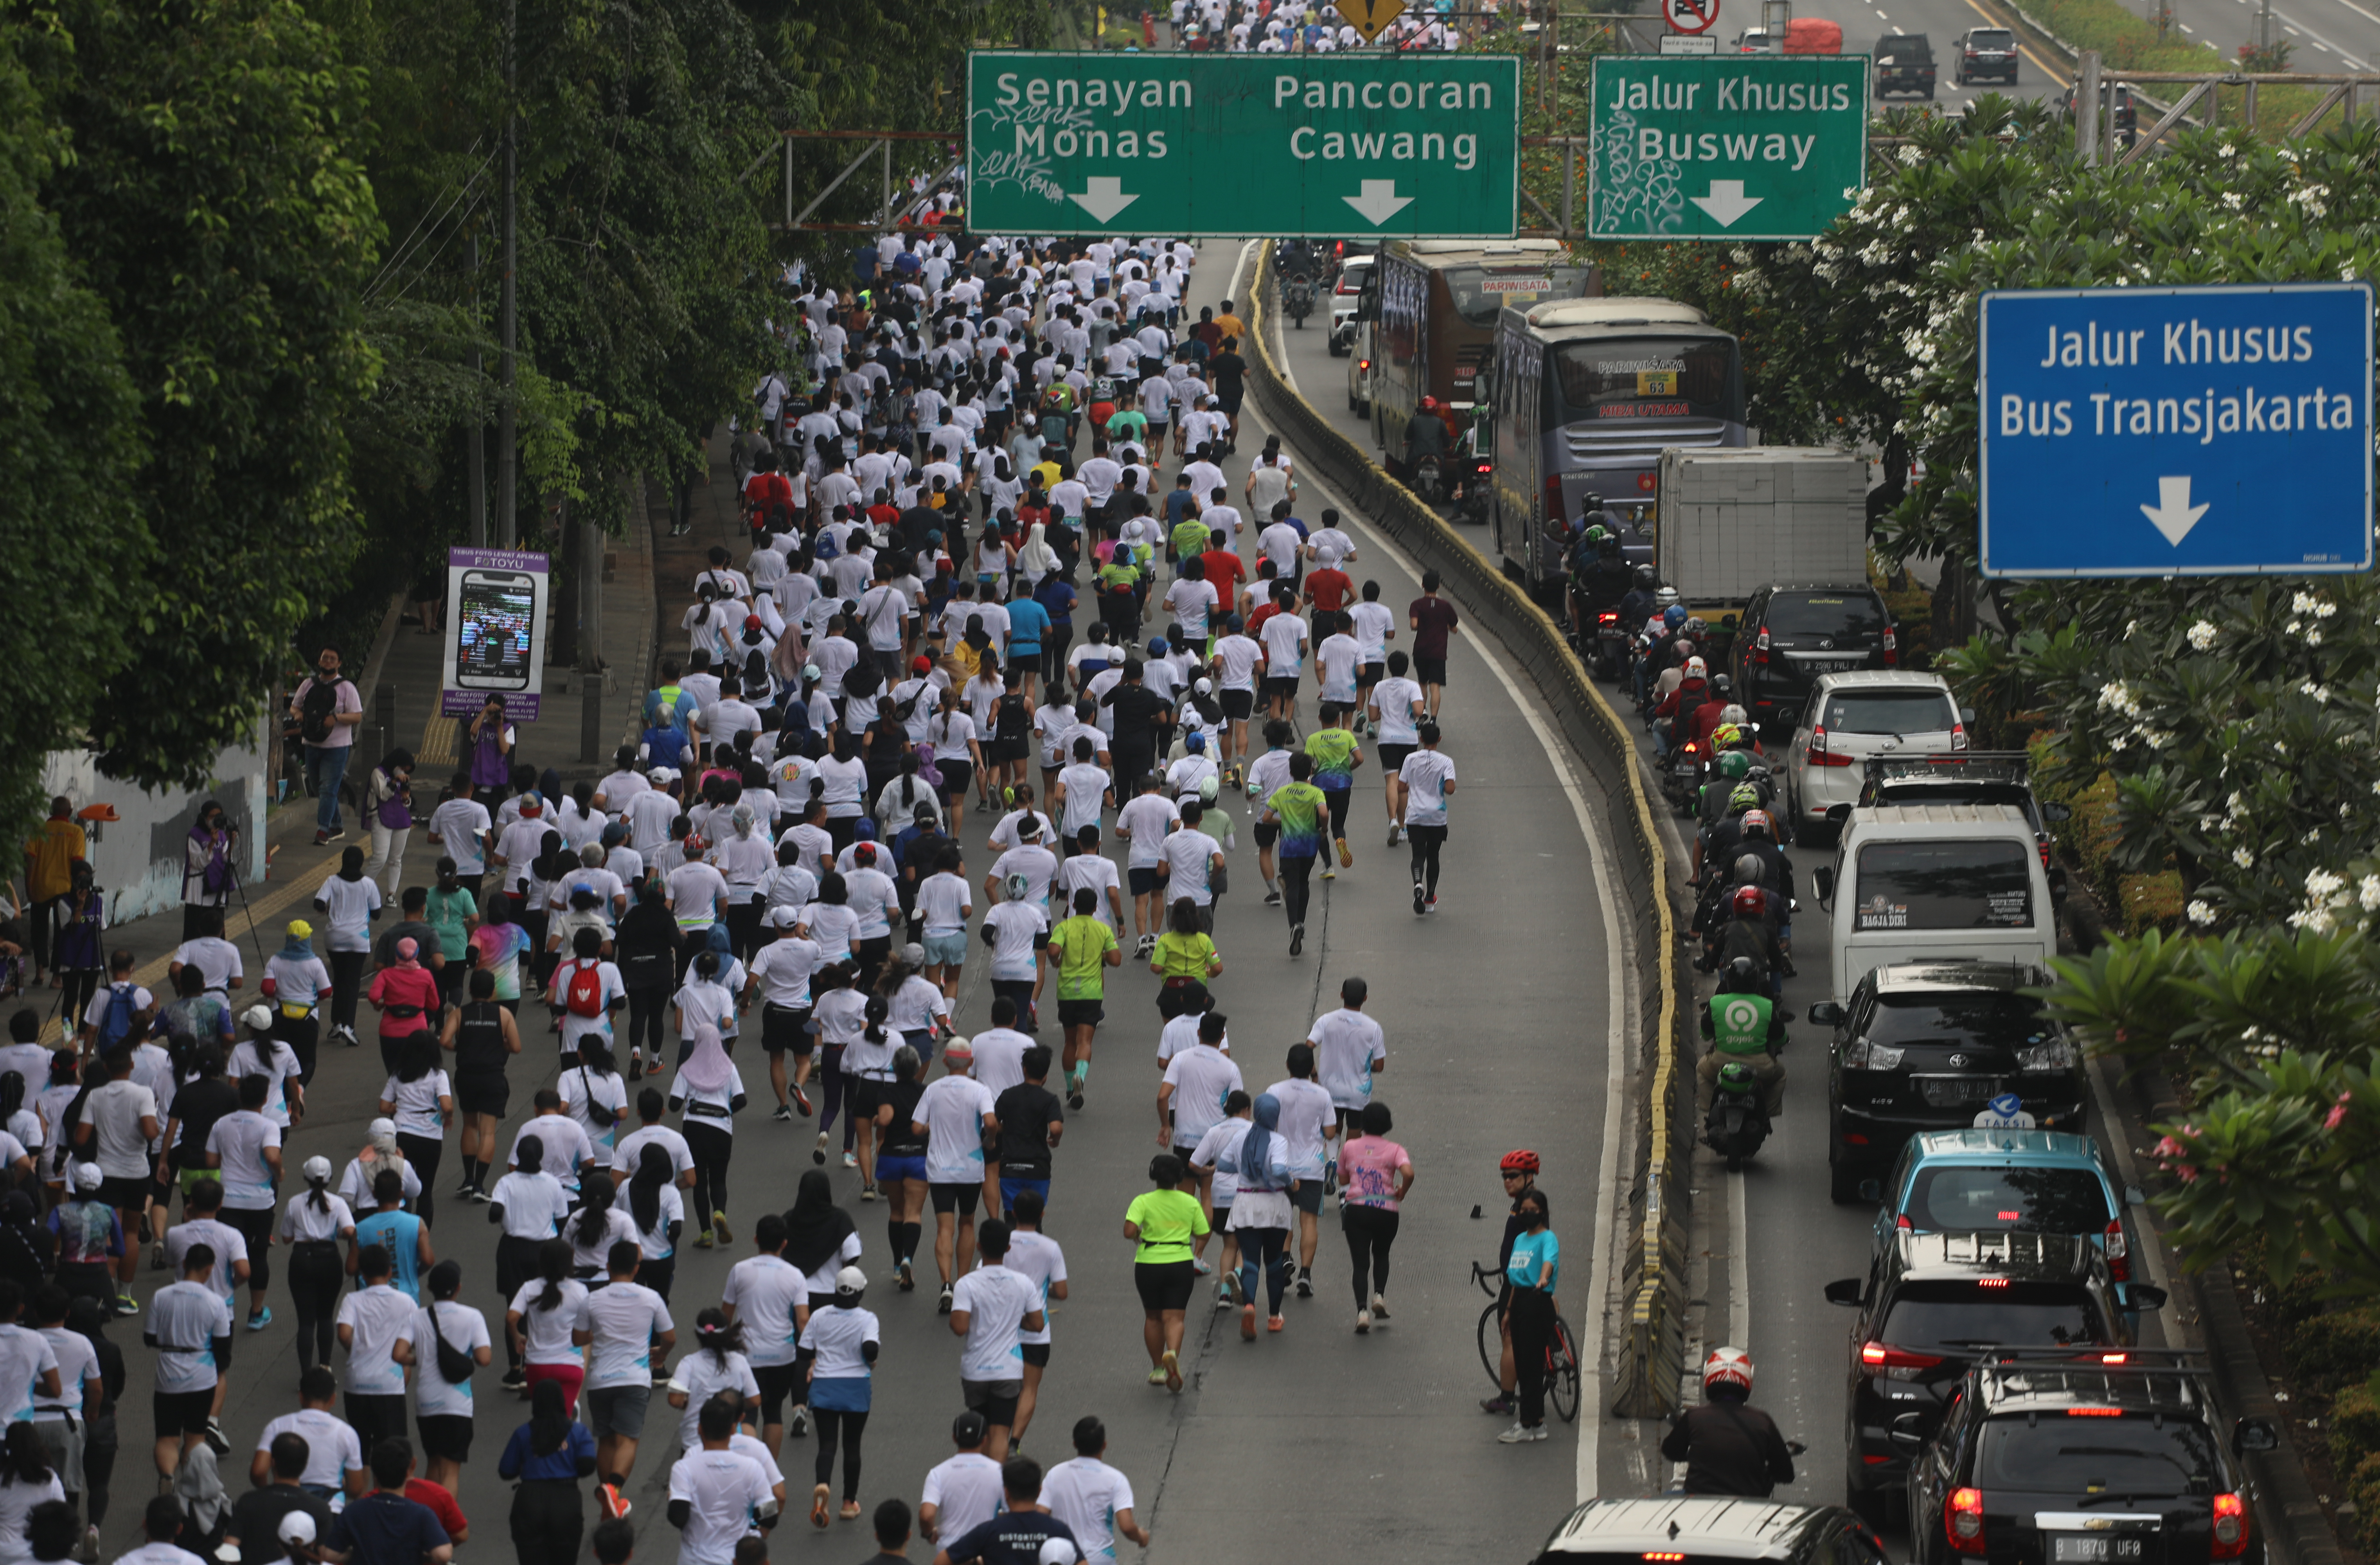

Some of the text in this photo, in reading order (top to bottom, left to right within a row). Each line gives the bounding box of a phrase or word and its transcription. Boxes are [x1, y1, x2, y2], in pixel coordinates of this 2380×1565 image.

[998, 72, 1192, 116] Senayan
[1275, 75, 1491, 109] Pancoran
[1609, 75, 1850, 111] Jalur Khusus
[1016, 124, 1167, 158] Monas
[1291, 126, 1477, 171] Cawang
[1638, 128, 1816, 171] Busway
[1483, 281, 1549, 292] PARIWISATA
[2040, 319, 2312, 368] Jalur Khusus
[1454, 367, 1476, 377] HIB
[1598, 359, 1686, 374] PARIWISATA
[1649, 381, 1665, 395] 63
[1599, 403, 1690, 418] HIBA UTAMA
[2001, 387, 2353, 445] Bus Transjakarta
[475, 556, 524, 569] FOTOYU
[1286, 787, 1307, 796] Fitbar
[1862, 914, 1907, 927] BAGJA DIRI
[1726, 1034, 1754, 1045] gojek
[1983, 1119, 2026, 1128] TAKSI
[999, 1532, 1048, 1542] DISTORTION
[1012, 1542, 1036, 1550] MILES
[2056, 1539, 2063, 1553] B
[2076, 1539, 2107, 1555] 1870
